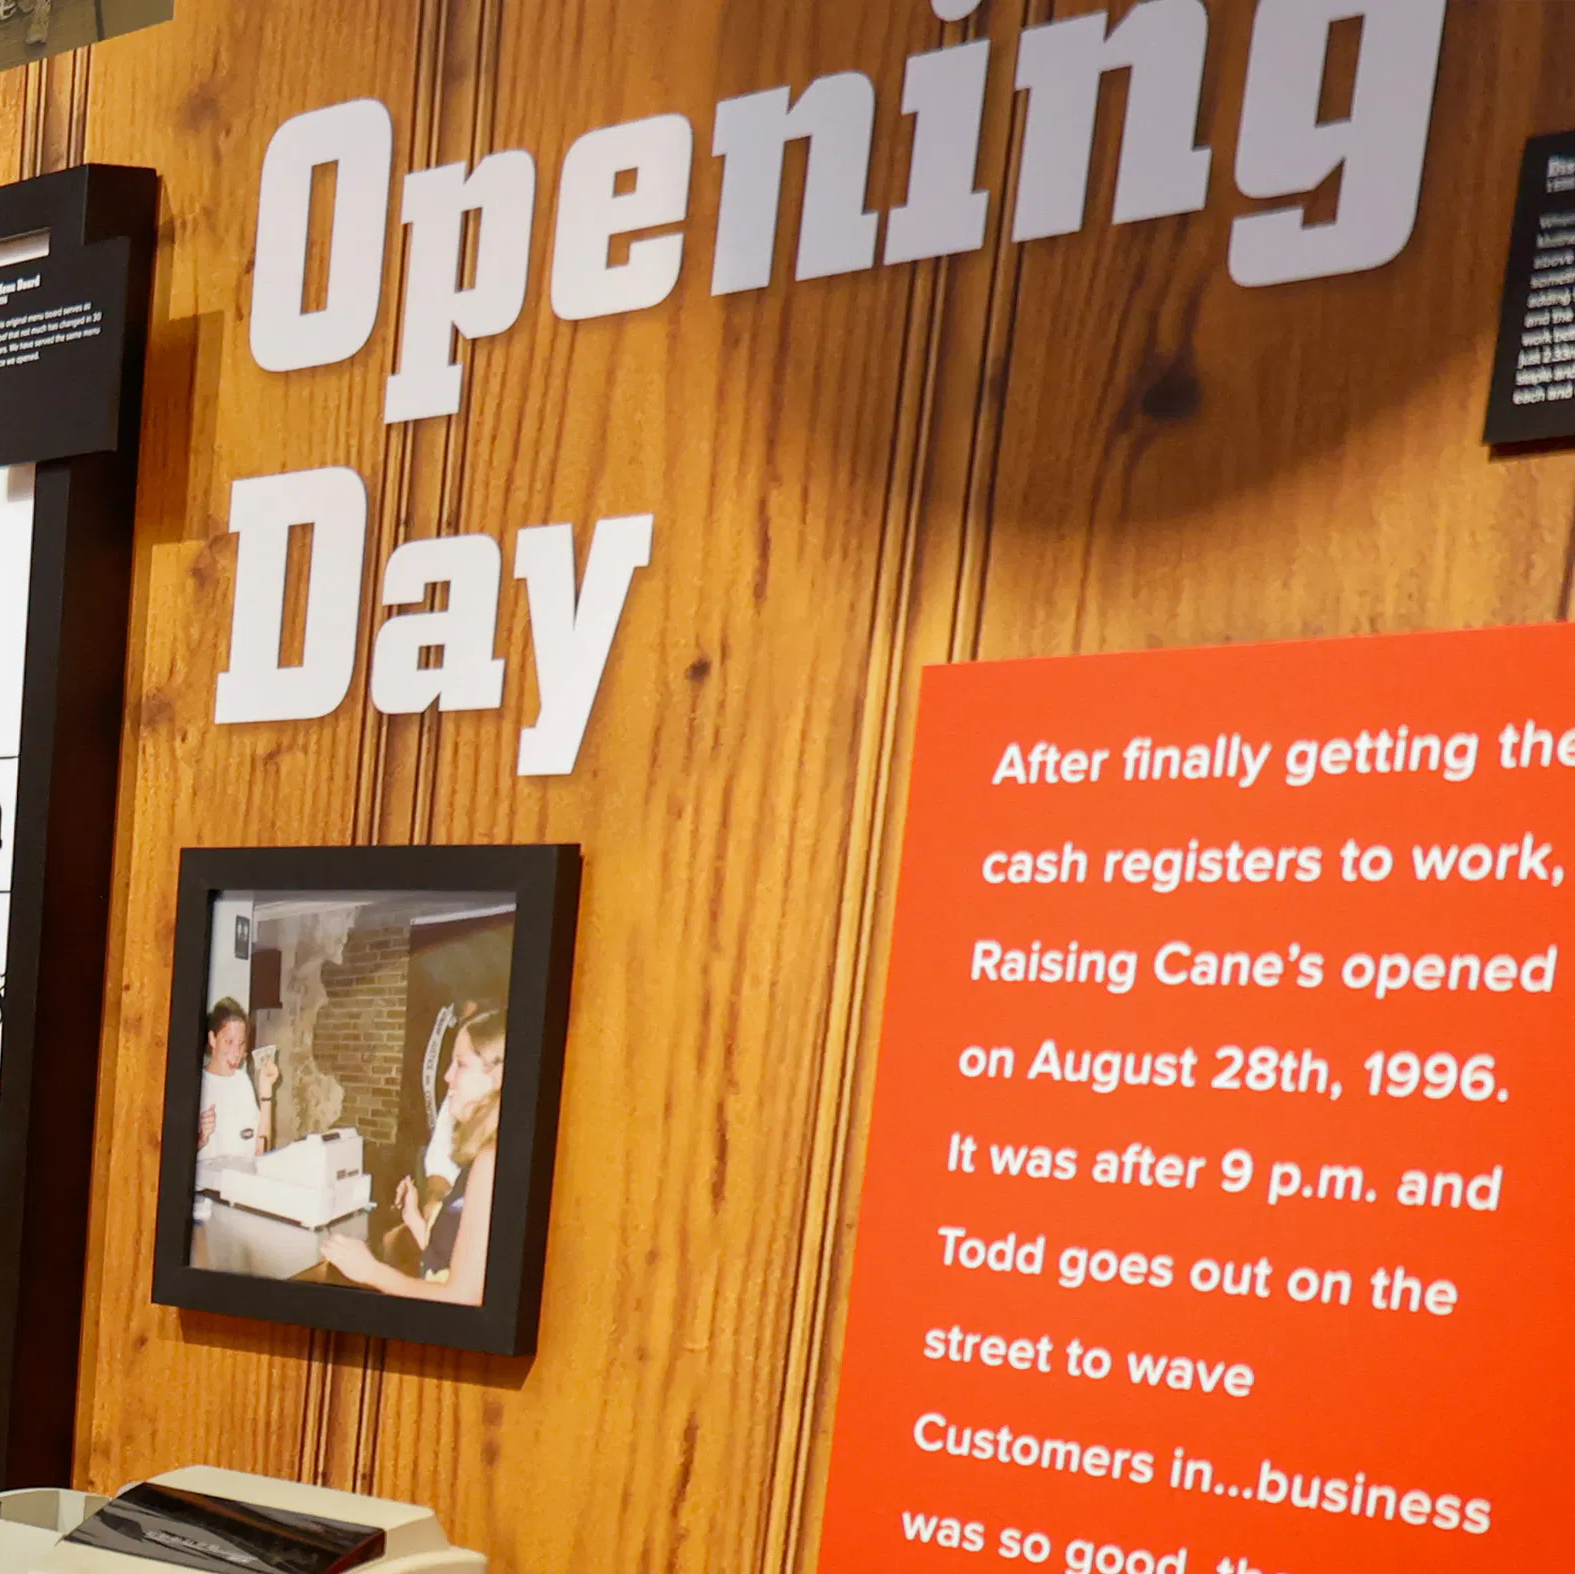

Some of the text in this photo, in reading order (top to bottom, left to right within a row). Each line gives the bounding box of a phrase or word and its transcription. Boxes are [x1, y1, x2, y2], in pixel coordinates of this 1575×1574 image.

[251, 0, 1448, 425] Opening
[214, 464, 654, 778] Day
[992, 720, 1575, 789] After finally getting the
[981, 832, 1565, 894] cash registers to work,
[970, 939, 1138, 996] Raising
[1341, 944, 1558, 1000] opened
[958, 1039, 1510, 1103] on August 28th, 1996.
[946, 1132, 1504, 1213] It was after 9 p.m. and
[937, 1226, 1458, 1318] Todd goes out on the
[923, 1324, 1255, 1399] street to wave
[912, 1412, 1493, 1536] Customers in...business
[901, 1511, 985, 1553] was
[998, 1526, 1050, 1564] so
